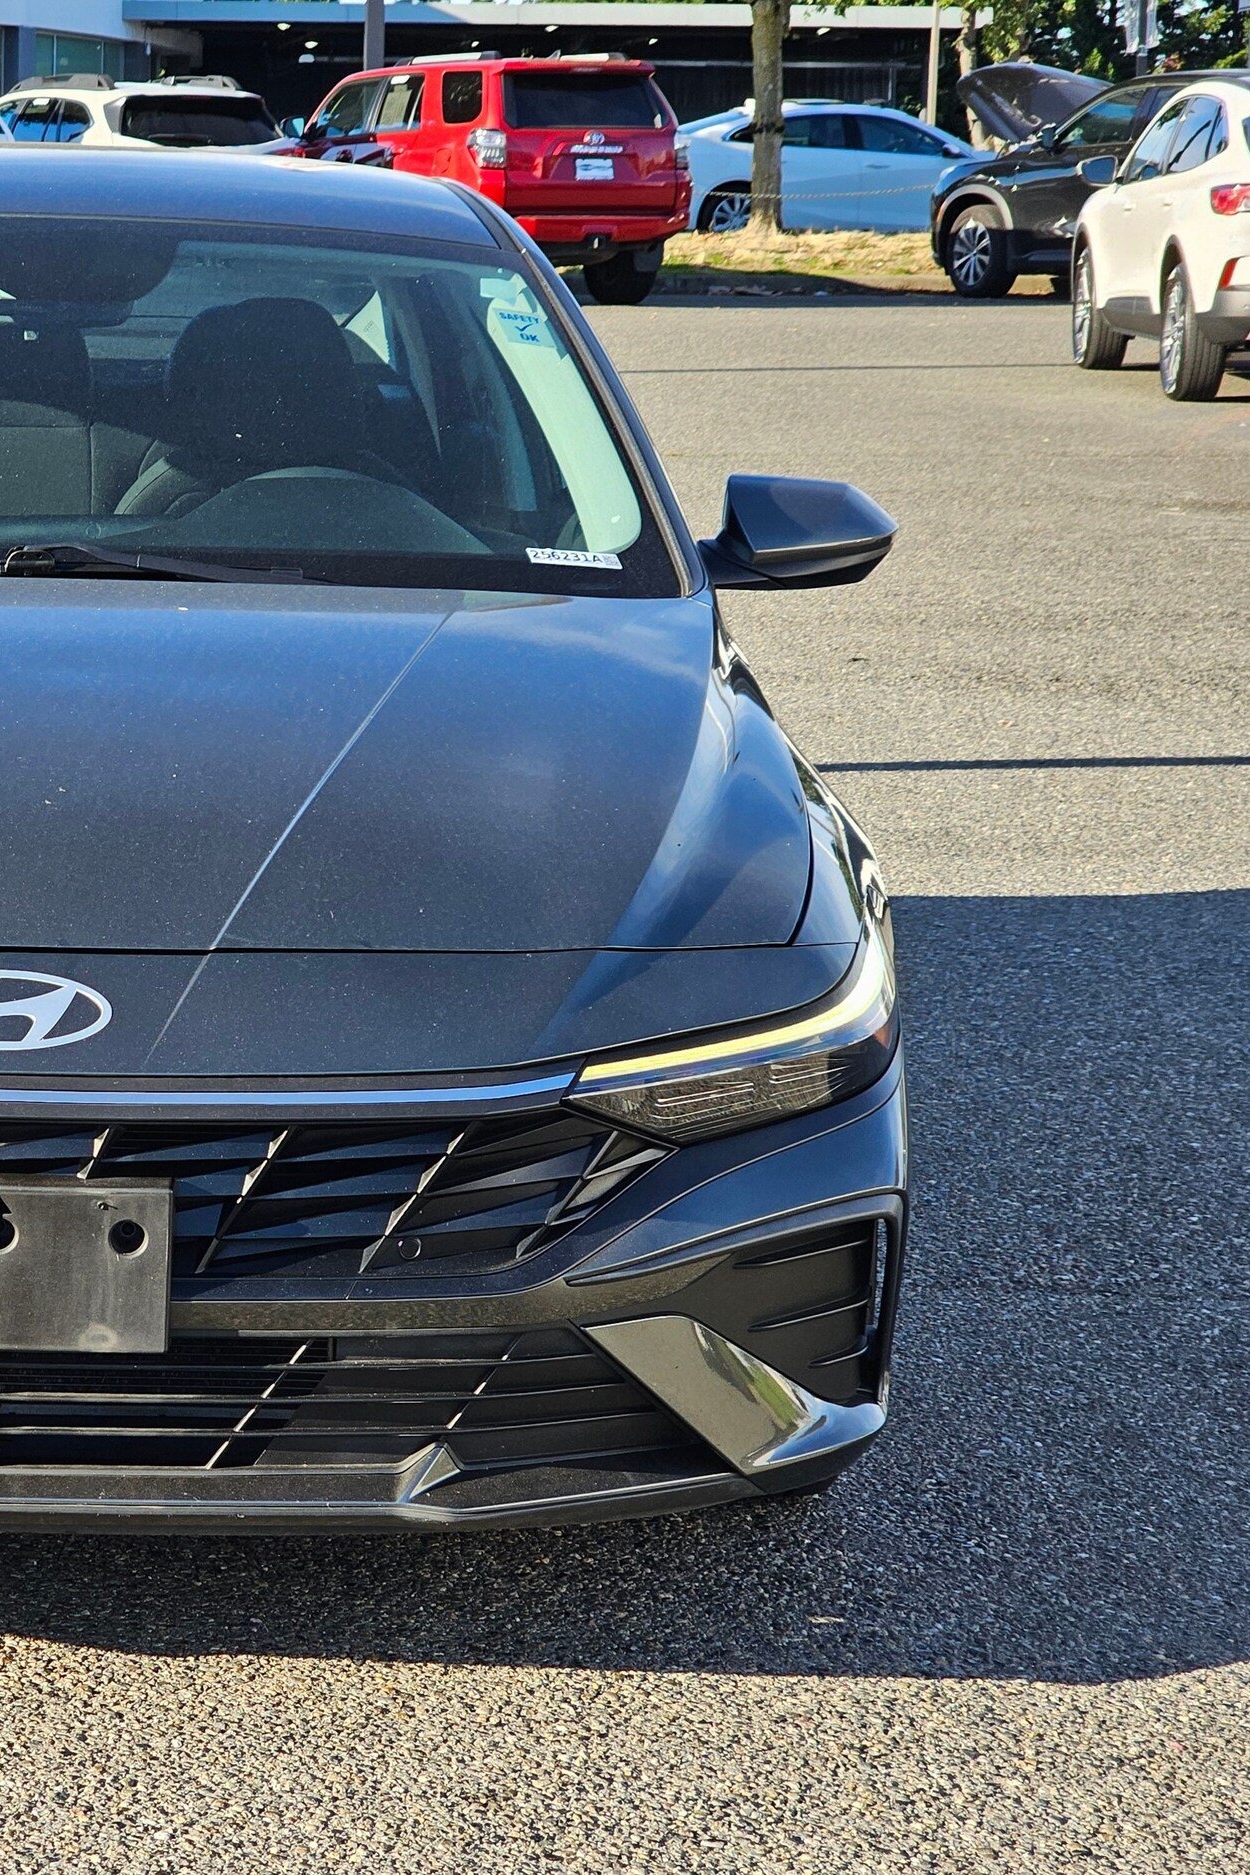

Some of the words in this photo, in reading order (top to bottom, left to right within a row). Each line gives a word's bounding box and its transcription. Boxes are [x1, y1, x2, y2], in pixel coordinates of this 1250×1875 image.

[499, 312, 540, 324] SAFETY
[519, 333, 540, 342] OK
[530, 549, 604, 563] 256231A
